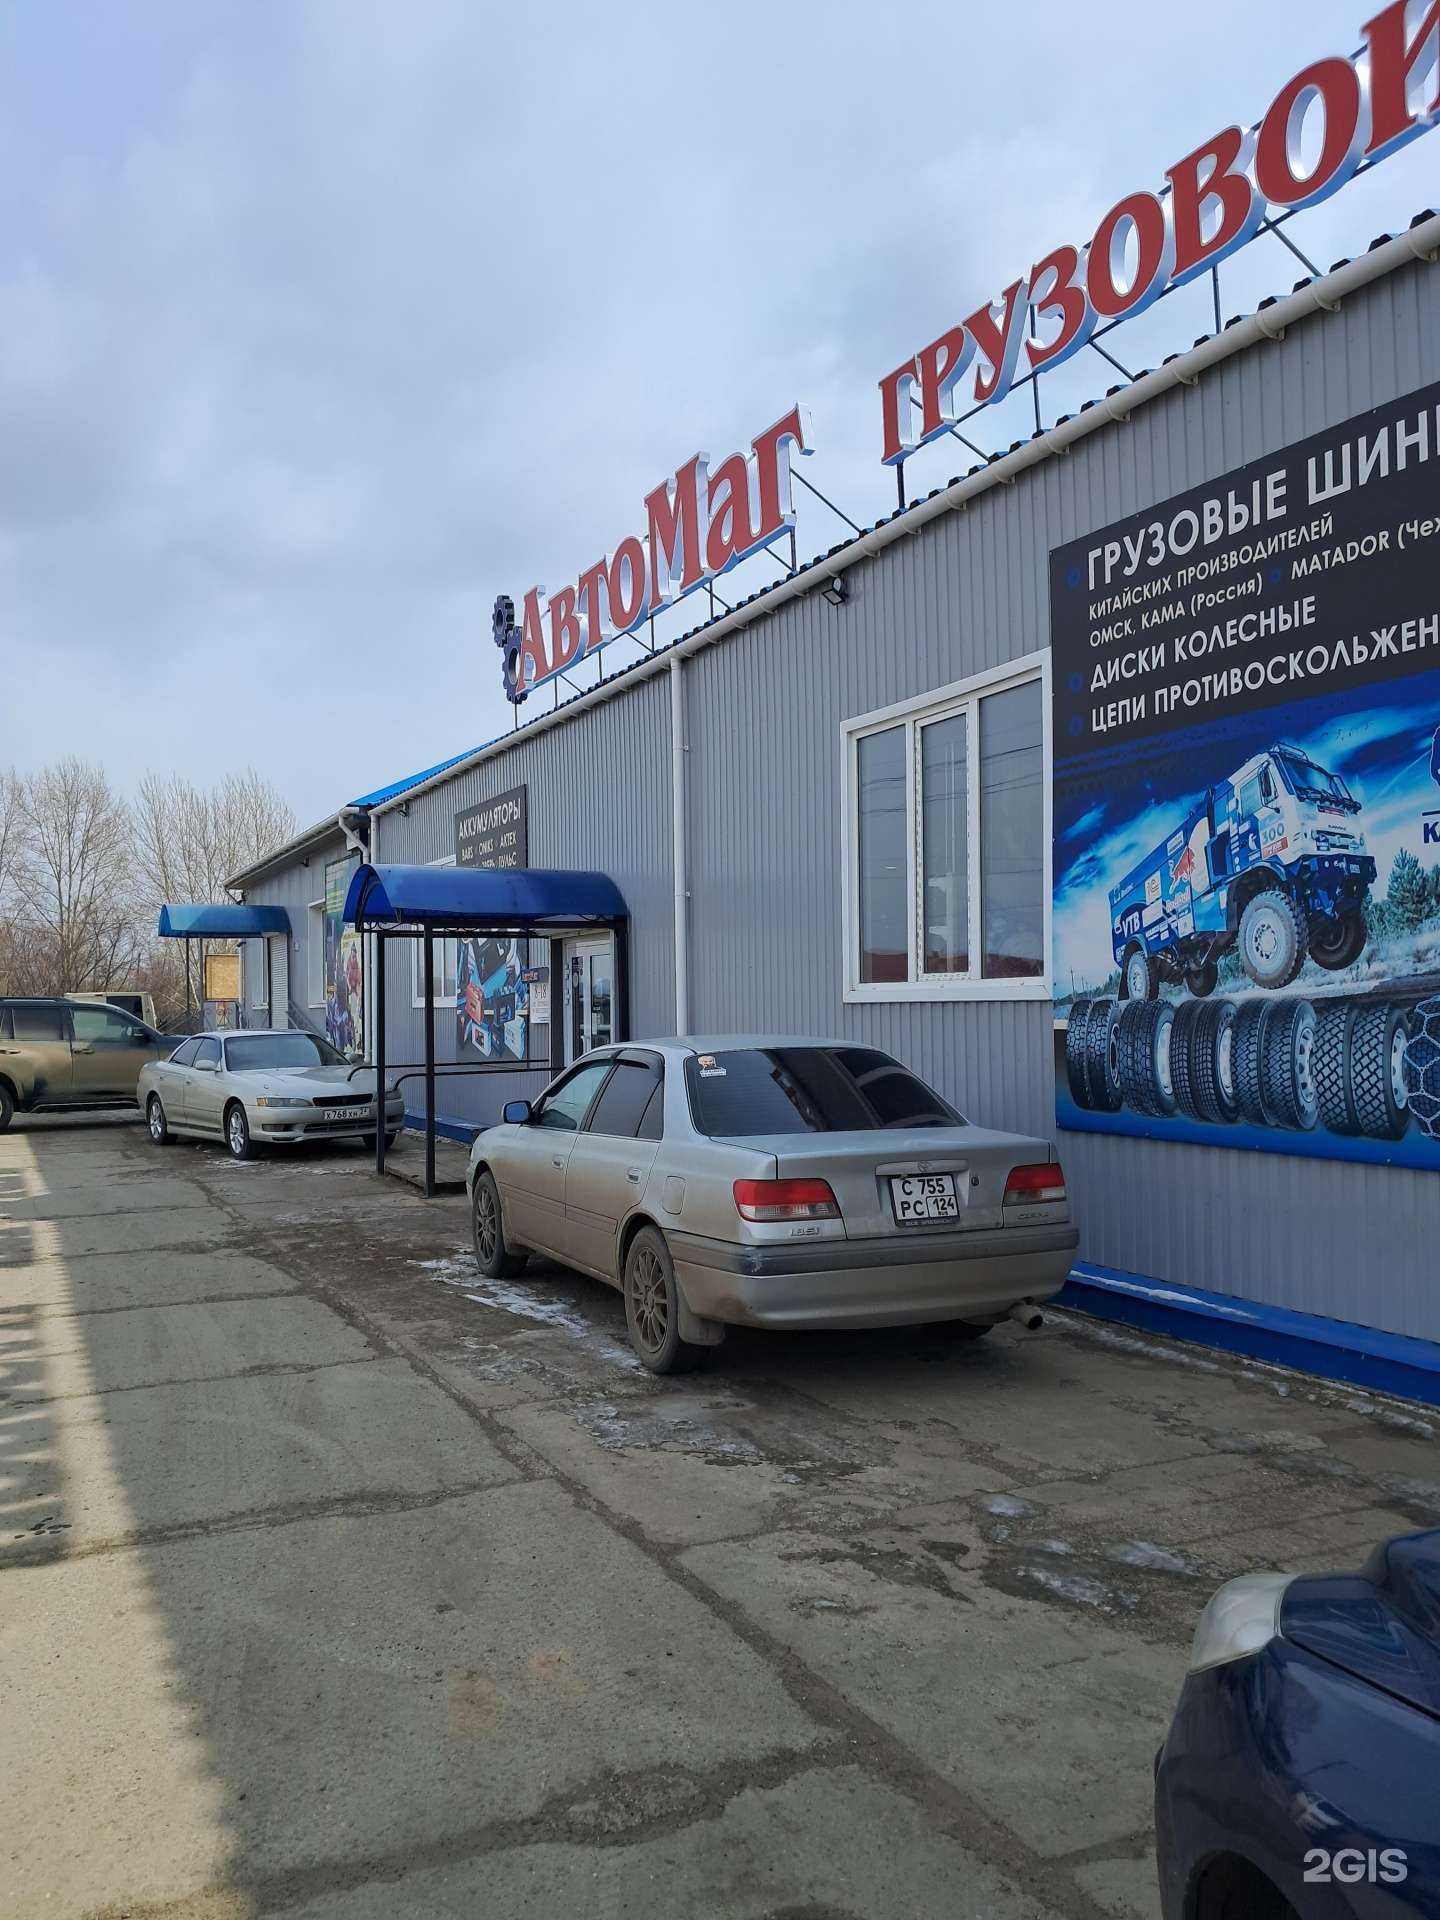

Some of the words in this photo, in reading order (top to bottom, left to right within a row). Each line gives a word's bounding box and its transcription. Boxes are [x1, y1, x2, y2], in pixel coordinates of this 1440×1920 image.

[1087, 468, 1288, 591] ГРУЗОВЫЕ
[1307, 404, 1440, 505] ШИН
[1089, 574, 1172, 621] КИТАЙСКИХ
[1177, 511, 1334, 588] ПРОИЗВОДИТЕЛЕЙ
[1089, 621, 1137, 647] ОМСК,
[1141, 602, 1186, 630] КАМА
[1190, 572, 1263, 617] (Россия)
[1291, 530, 1390, 580] MATADOR
[1090, 642, 1165, 692] ДИСКИ
[1174, 595, 1317, 663] КОЛЕСНЫЕ
[1091, 694, 1146, 734] ЦЕПИ
[1154, 612, 1440, 715] ПРОТИВОСКОЛЬЖЕН
[459, 797, 521, 841] АККУМУЛЯТОРЫ
[917, 1177, 946, 1195] 755
[932, 1197, 955, 1211] 124
